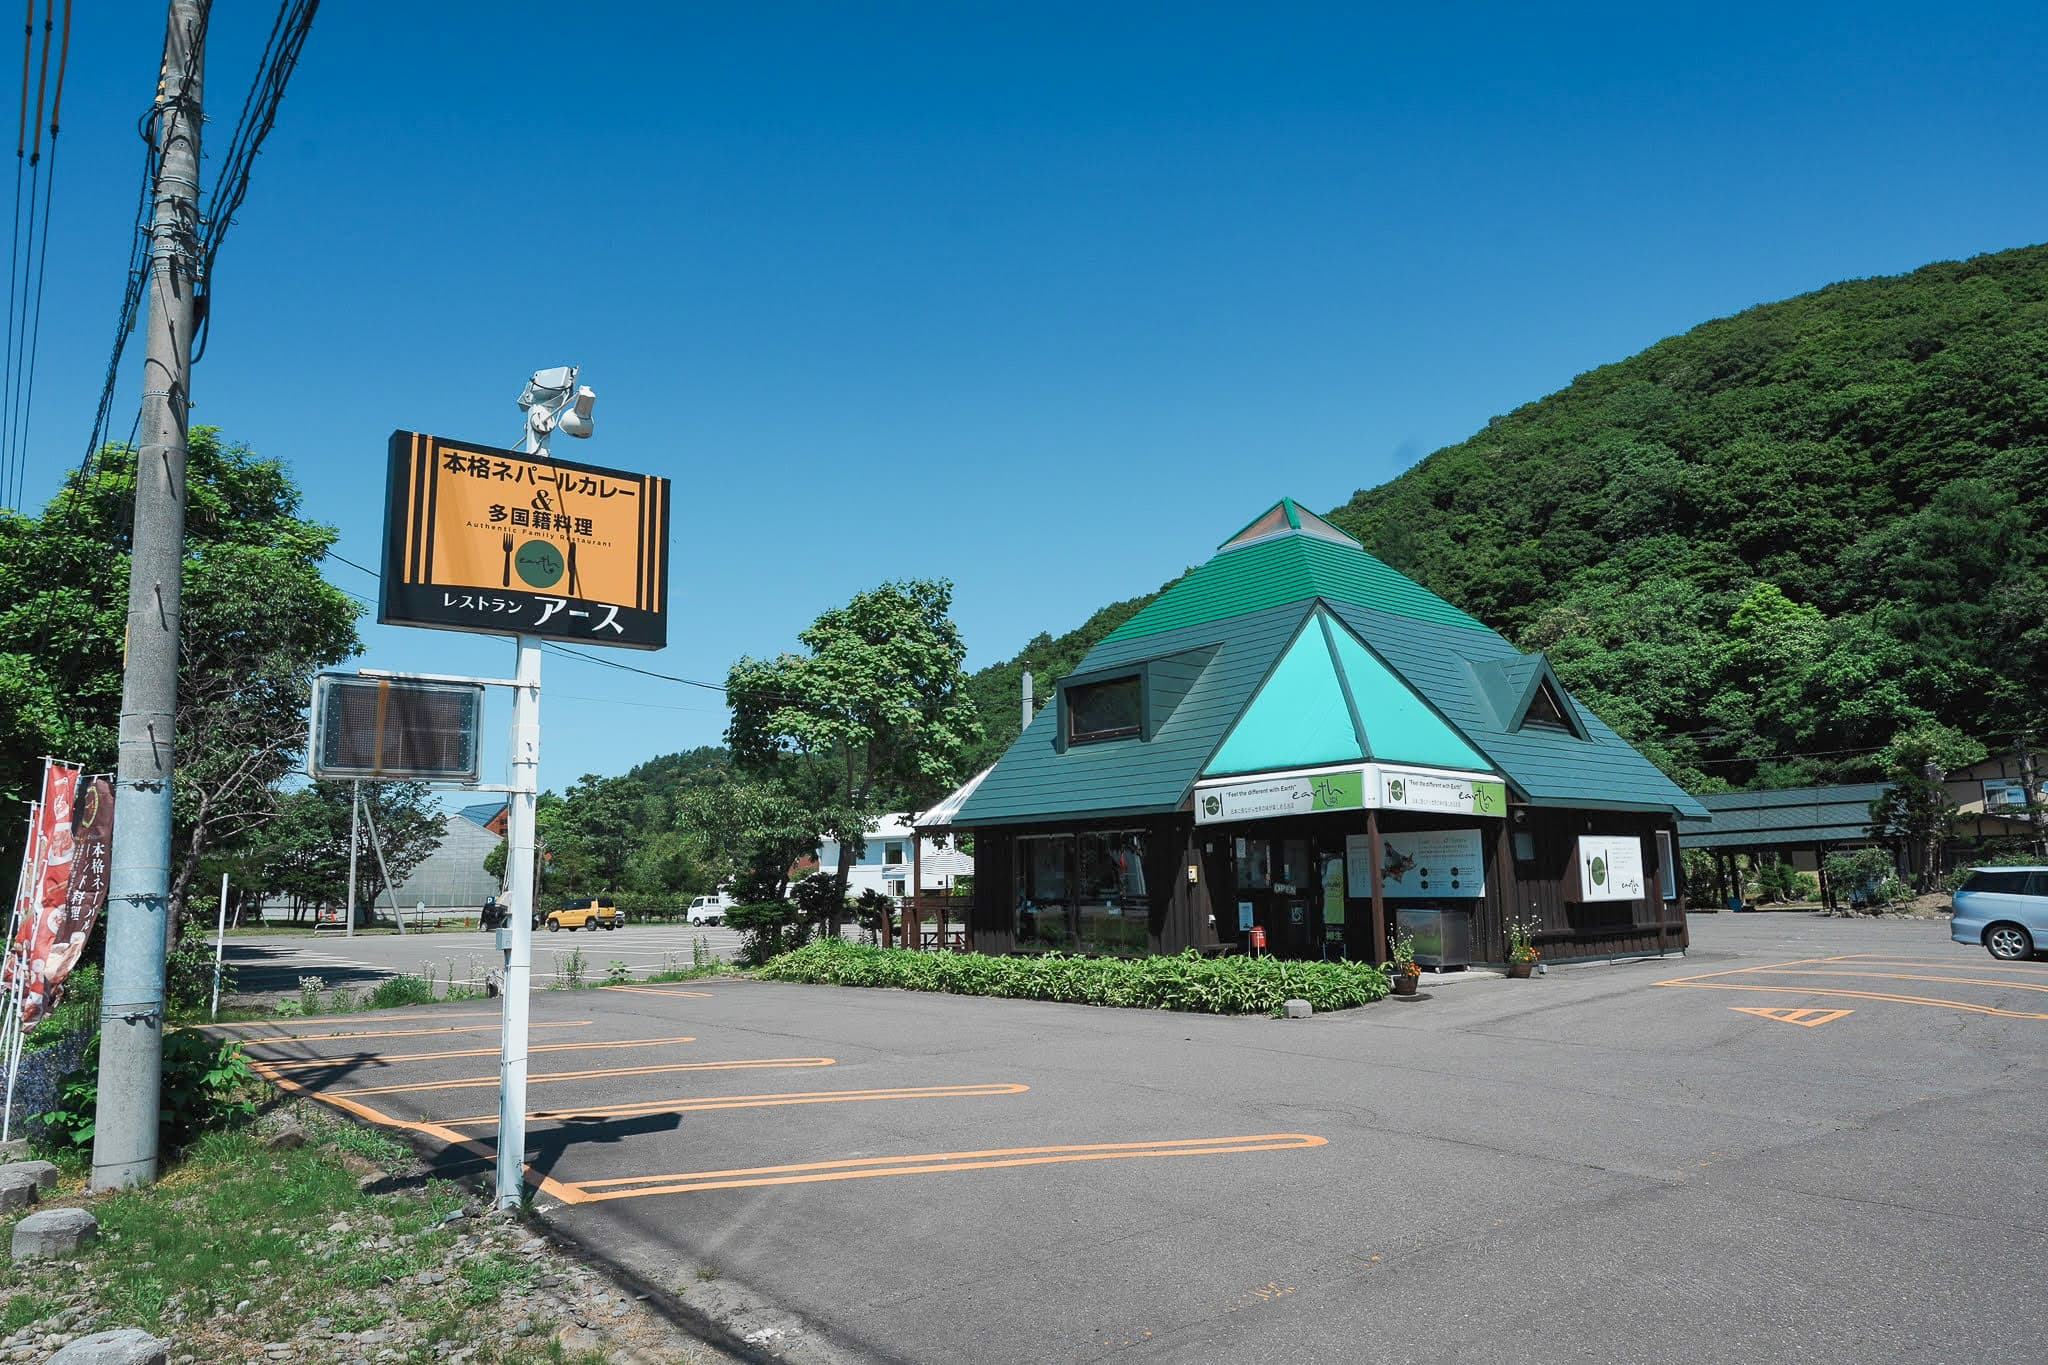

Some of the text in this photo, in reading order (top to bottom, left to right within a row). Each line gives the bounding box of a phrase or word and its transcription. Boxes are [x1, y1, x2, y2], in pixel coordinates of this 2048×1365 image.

[442, 452, 635, 498] 本格ネパールカレー
[531, 489, 555, 511] &
[488, 504, 593, 536] 多国籍料理
[466, 521, 612, 548] Authentic Family Restaurant
[444, 592, 624, 634] レストラン アース
[1292, 779, 1344, 808] earth
[1458, 785, 1494, 812] earth
[1273, 883, 1296, 895] OPEN
